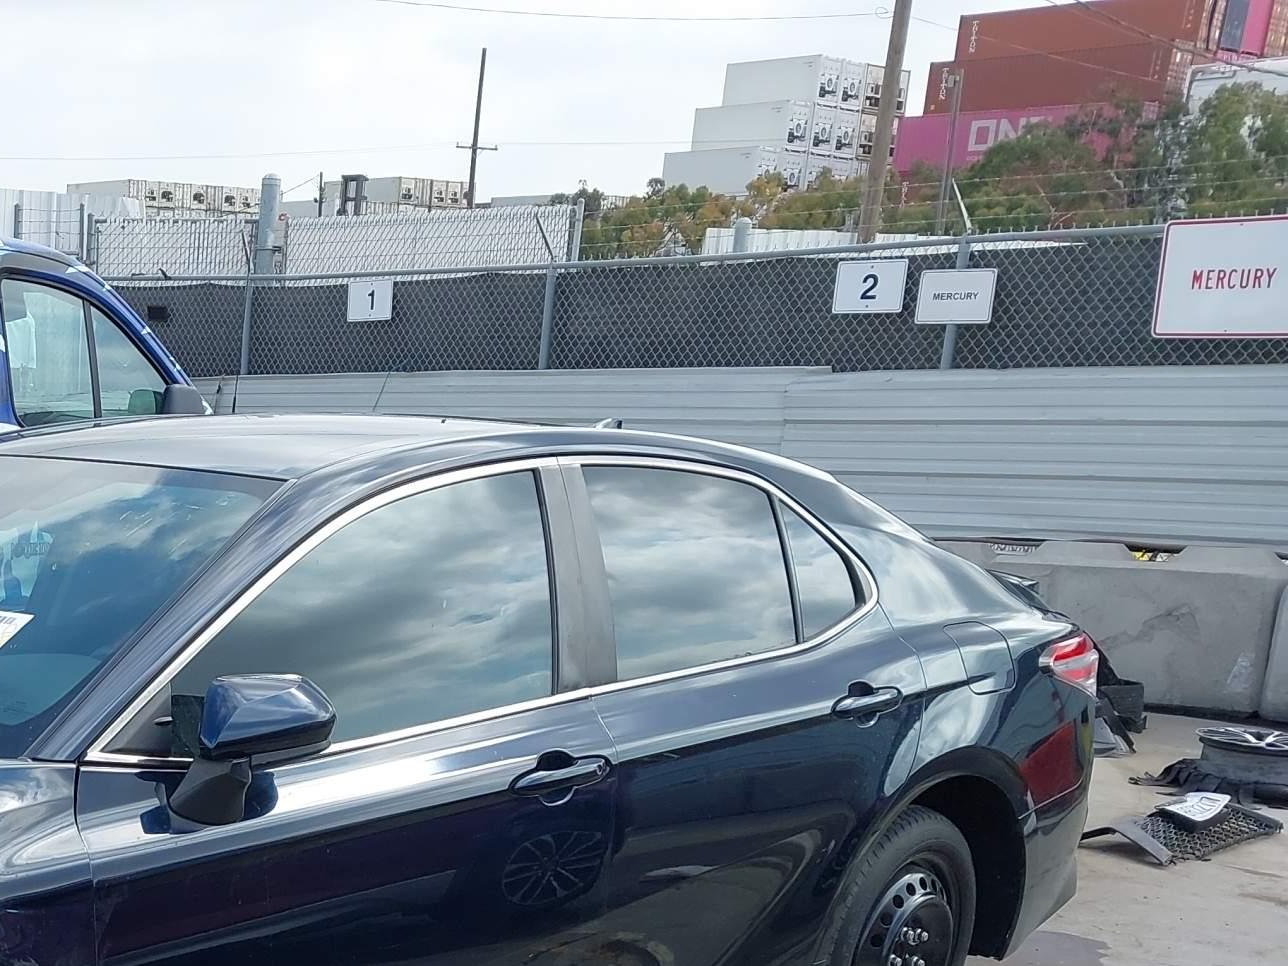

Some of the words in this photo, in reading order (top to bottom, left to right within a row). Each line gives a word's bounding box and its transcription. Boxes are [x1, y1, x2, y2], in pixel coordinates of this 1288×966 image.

[860, 273, 879, 300] 2
[1192, 267, 1278, 290] MERCURY
[367, 289, 375, 311] 1
[932, 292, 980, 302] MERCURY
